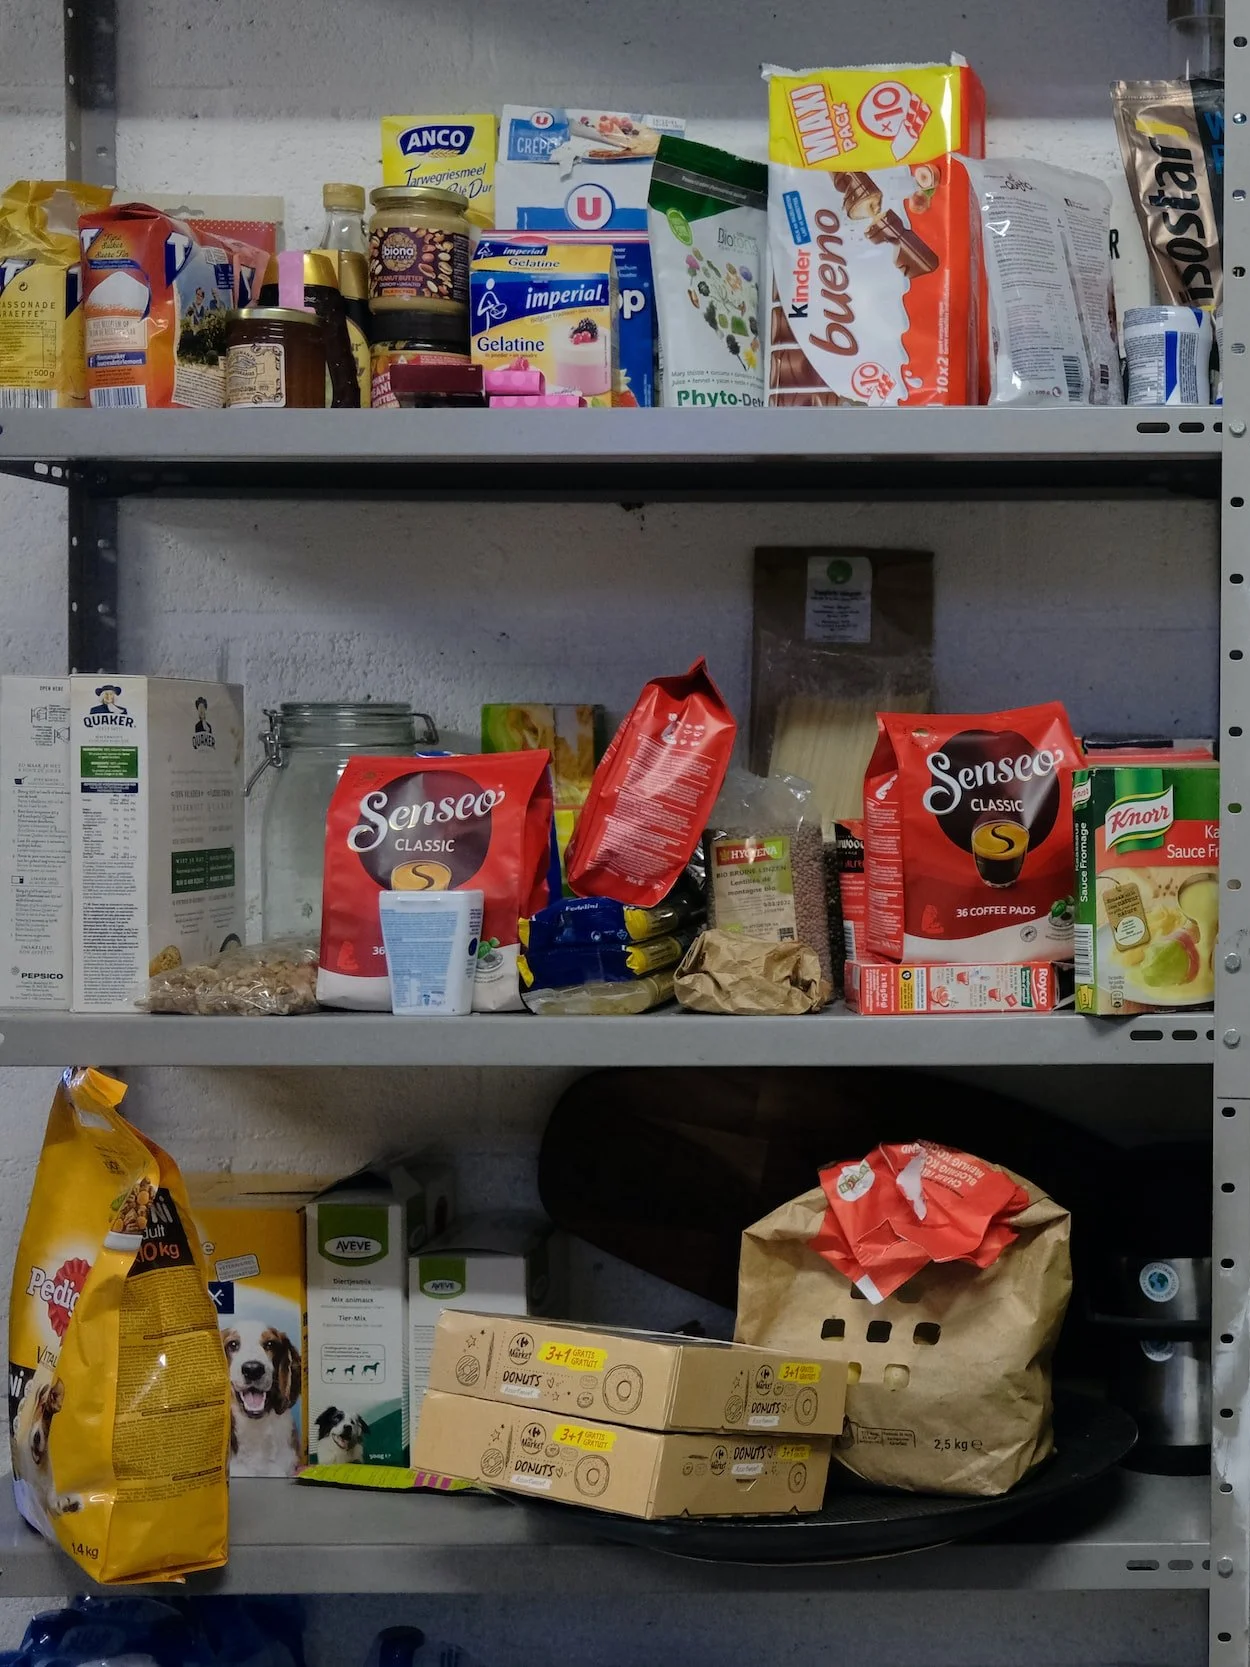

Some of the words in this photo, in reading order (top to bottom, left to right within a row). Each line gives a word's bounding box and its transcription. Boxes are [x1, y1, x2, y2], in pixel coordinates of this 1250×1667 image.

[790, 84, 840, 165] MAXI
[832, 103, 858, 152] PACK
[407, 129, 466, 150] ANCO
[517, 135, 553, 154] CRÊPE
[403, 163, 487, 187] Tarwegriesmeel
[469, 179, 494, 199] Dur
[577, 196, 602, 221] U
[384, 246, 414, 256] biona
[503, 247, 545, 256] imperial
[508, 258, 561, 268] Gelatine
[808, 209, 860, 356] bueno
[525, 283, 603, 310] imperial
[477, 337, 545, 351] Gelatine
[677, 389, 765, 408] Phyto-Det
[83, 714, 135, 729] QUAKER
[192, 733, 216, 749] QUAKER
[922, 748, 1065, 817] Senseo
[970, 798, 1025, 813] CLASSIC
[346, 787, 505, 854] Senseo
[1107, 804, 1170, 835] Knorr
[394, 837, 455, 853] CLASSIC
[1080, 822, 1090, 869] Fromage
[1167, 844, 1206, 859] Sauce
[1080, 870, 1089, 903] Sauce
[565, 903, 599, 912] Fedelini
[956, 908, 969, 918] 36
[970, 906, 1007, 918] COFFEE
[1009, 905, 1037, 916] PADS
[21, 972, 64, 980] PEPSICO
[1036, 967, 1049, 1006] Royco
[142, 1225, 166, 1240] dult
[159, 1242, 180, 1260] kg
[335, 1240, 371, 1252] AVEVE
[26, 1266, 80, 1315] Pedi
[432, 1282, 455, 1290] AVEVE
[37, 1345, 58, 1369] VITAL
[508, 1348, 533, 1361] Market
[545, 1345, 572, 1362] 3+1
[572, 1350, 597, 1360] GRATIS
[571, 1357, 599, 1369] GRATUIT
[502, 1370, 541, 1388] DONUTS
[751, 1401, 782, 1414] DONUTS
[521, 1436, 545, 1451] Market
[559, 1427, 584, 1444] 3+1
[584, 1431, 607, 1442] GRATIS
[583, 1439, 609, 1451] GRATUIT
[733, 1445, 767, 1460] DONUTS
[934, 1438, 949, 1451] 2,5
[950, 1438, 969, 1452] kg
[514, 1459, 555, 1478] DONUTS
[85, 1545, 100, 1560] kg
